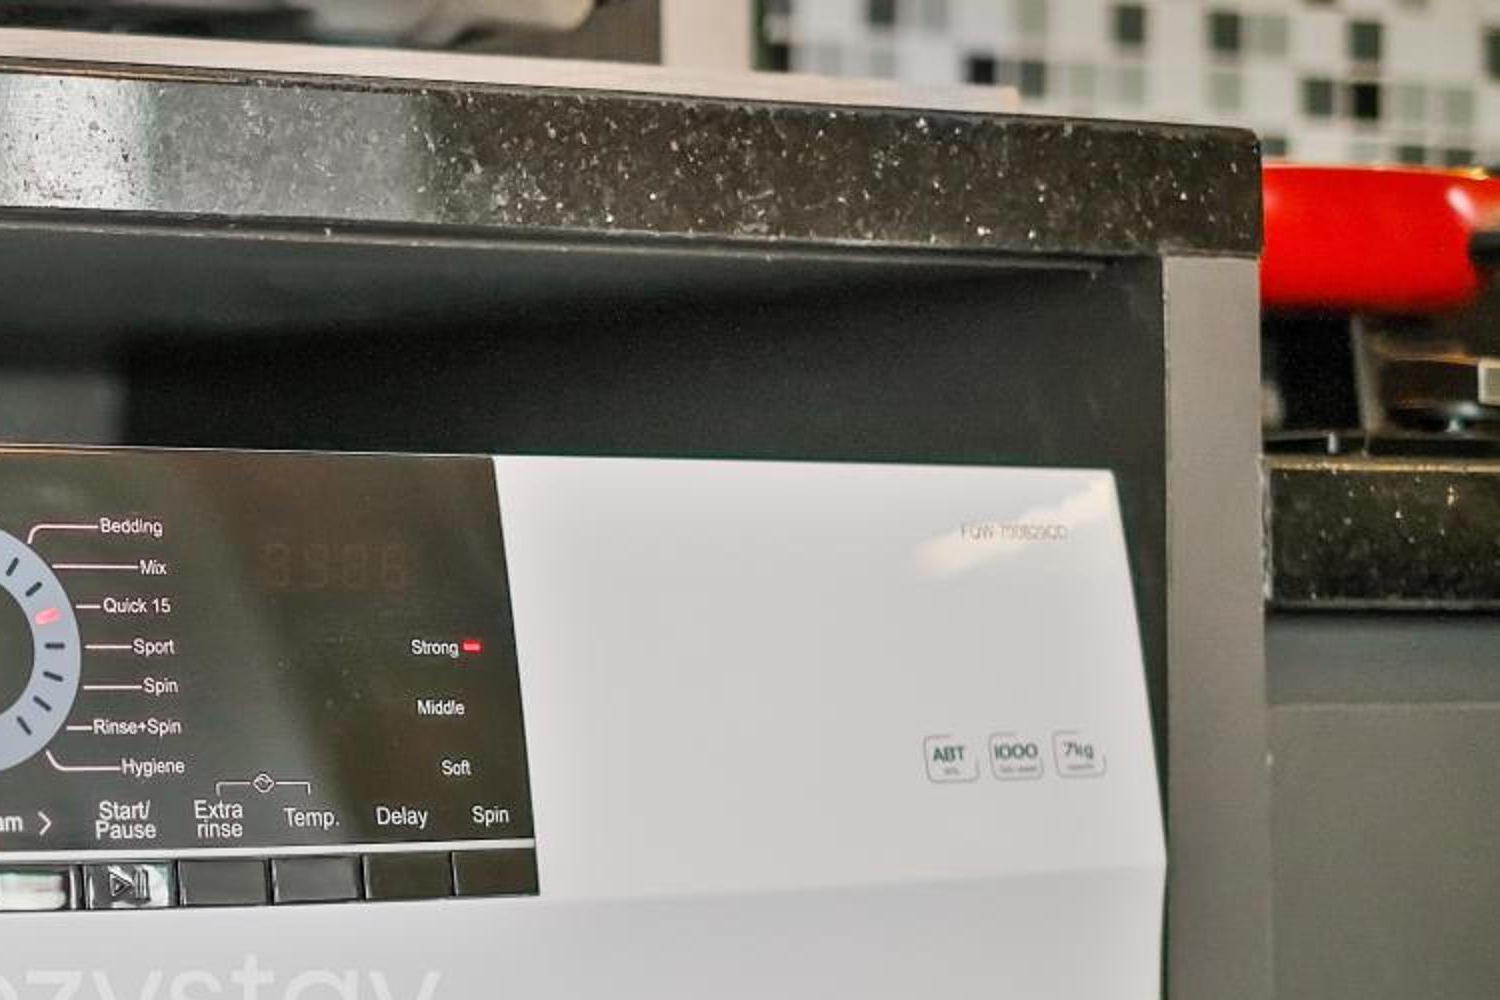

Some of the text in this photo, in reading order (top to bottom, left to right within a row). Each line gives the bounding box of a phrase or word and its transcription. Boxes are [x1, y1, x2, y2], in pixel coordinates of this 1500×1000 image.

[101, 518, 163, 537] Bedding
[140, 560, 167, 575] Mix
[103, 598, 171, 615] Quick 15
[133, 639, 175, 657] Sport
[411, 639, 459, 657] Strong
[143, 678, 179, 695] Spin
[417, 700, 465, 716] Middle
[93, 719, 182, 737] Rinse+Spin
[932, 745, 965, 763] ABT
[121, 758, 185, 776] Hygiene
[441, 759, 472, 775] Soft
[99, 800, 151, 821] Start/
[194, 800, 243, 819] Extra
[284, 808, 340, 829] Temp.
[376, 807, 429, 829] Delay
[473, 806, 510, 826] Spin
[95, 822, 156, 840] Pause
[197, 820, 243, 838] rinse
